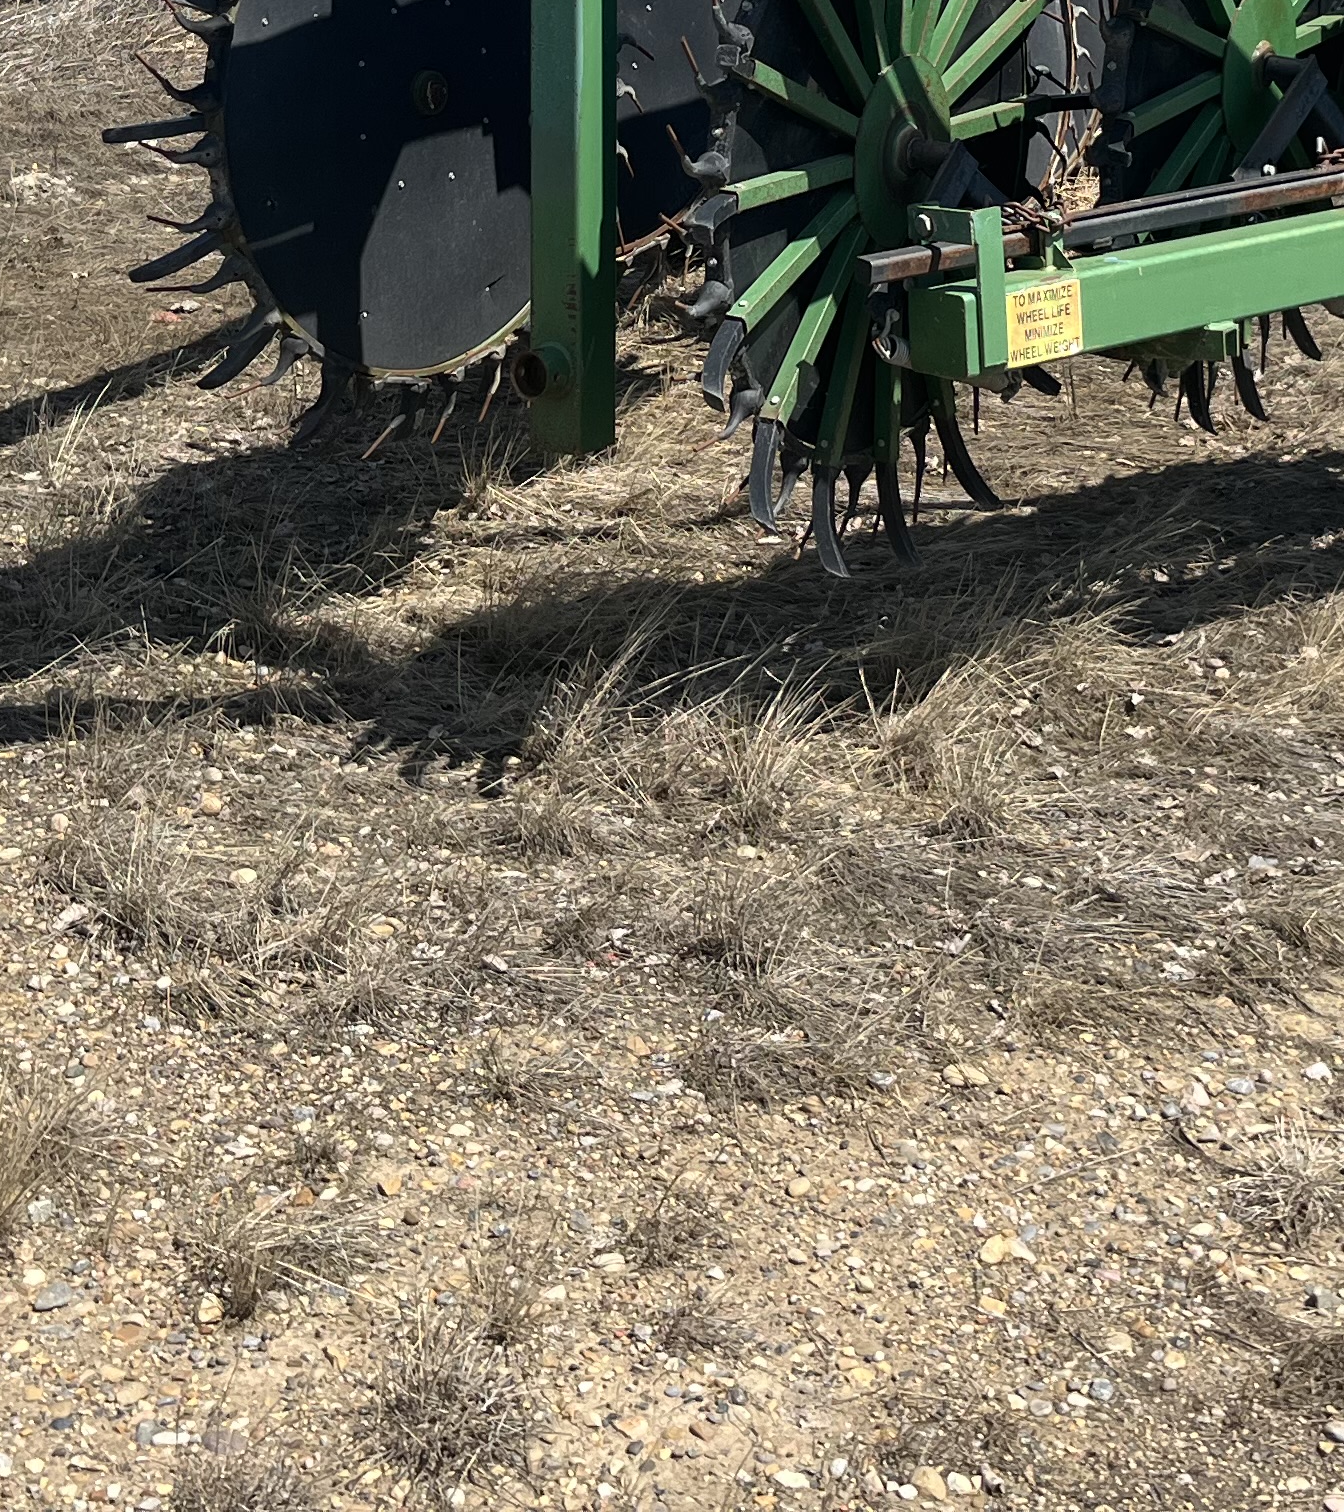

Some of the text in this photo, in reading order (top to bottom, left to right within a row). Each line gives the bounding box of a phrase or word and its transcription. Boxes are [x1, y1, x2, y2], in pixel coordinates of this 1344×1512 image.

[1012, 285, 1073, 308] TO MAXIMIZE
[1016, 303, 1071, 325] WHEEL LIFE
[1024, 321, 1065, 342] MINIMIZE
[1010, 345, 1043, 363] WHEEL
